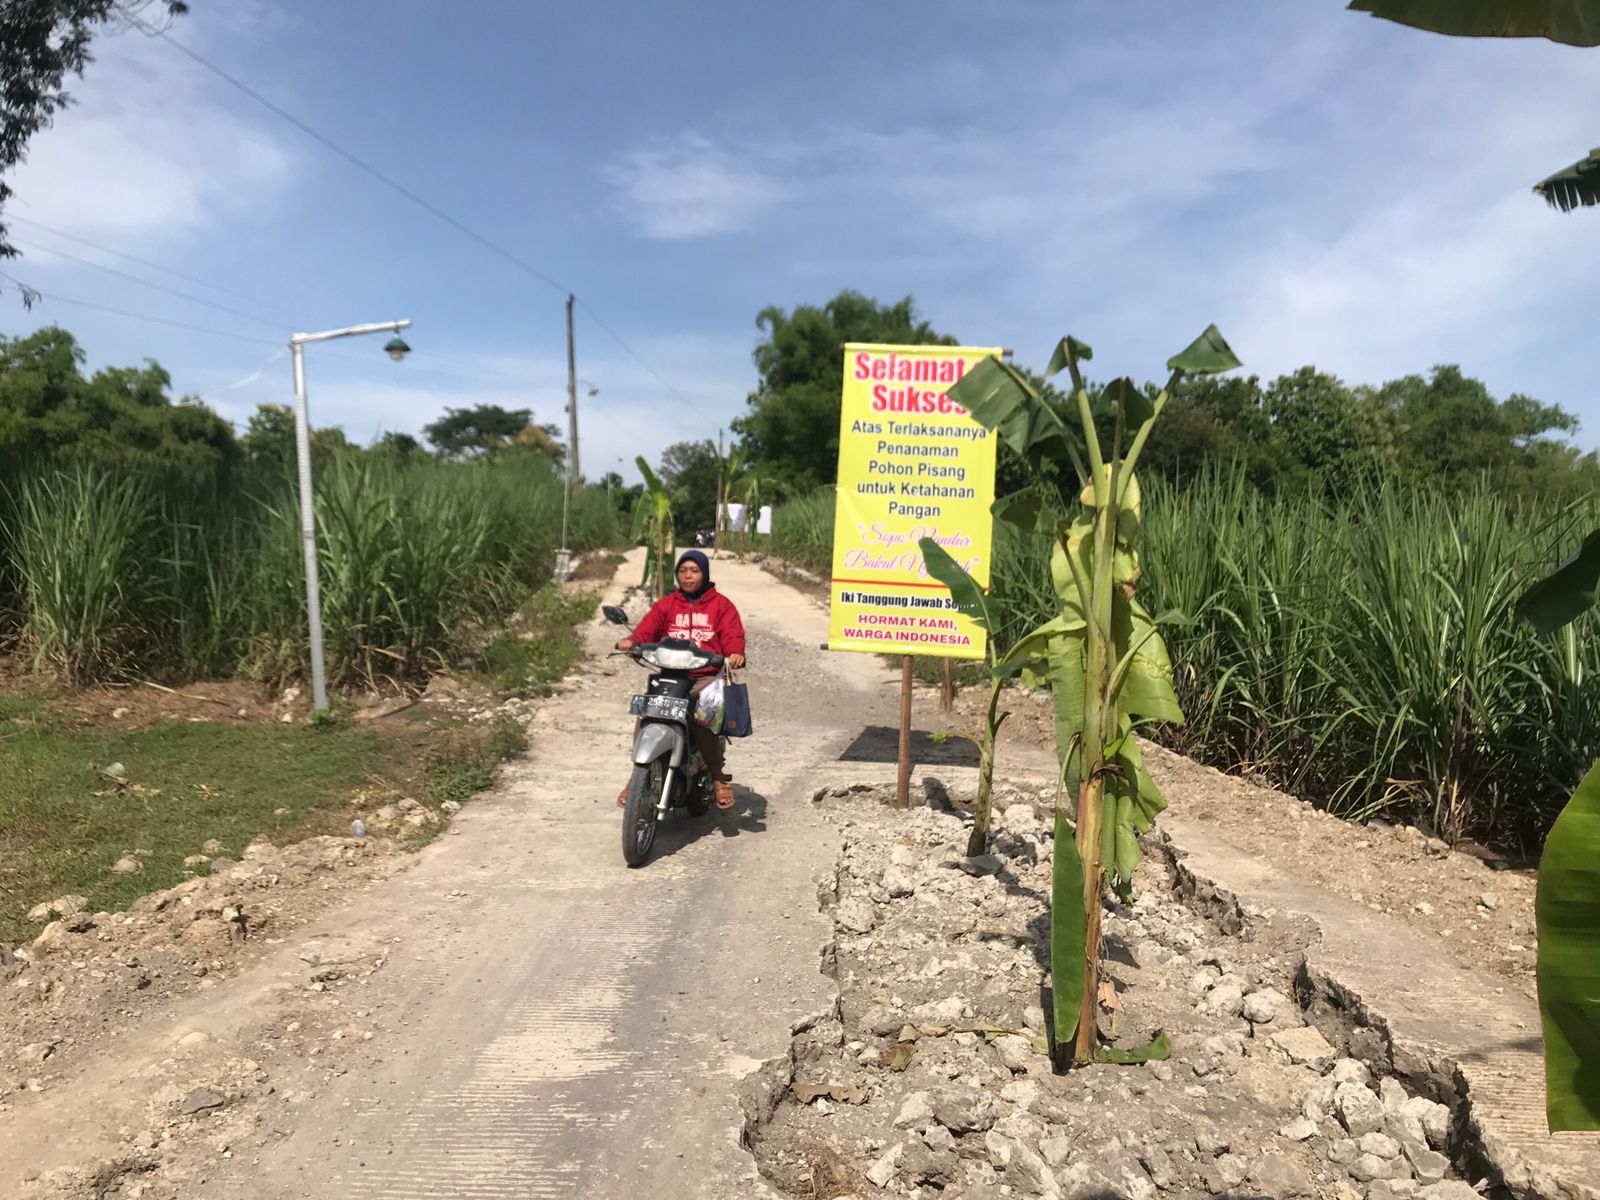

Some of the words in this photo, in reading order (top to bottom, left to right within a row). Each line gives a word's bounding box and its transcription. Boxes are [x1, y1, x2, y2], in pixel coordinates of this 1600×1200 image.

[855, 352, 966, 383] Selamat
[851, 420, 882, 434] Atas
[888, 421, 986, 441] Terlaksananya
[877, 441, 959, 457] Penanaman
[869, 460, 913, 476] Pohon
[917, 463, 966, 481] Pisang
[857, 482, 896, 495] untuk
[901, 482, 975, 499] Ketahanan
[888, 502, 940, 519] Pangan
[841, 592, 855, 603] Iki
[857, 592, 909, 607] Tanggung
[910, 596, 943, 609] Jawab
[858, 614, 916, 628] HORMAT
[919, 617, 958, 631] KAMI,
[844, 628, 893, 640] WARGA
[895, 631, 971, 645] INDONESIA
